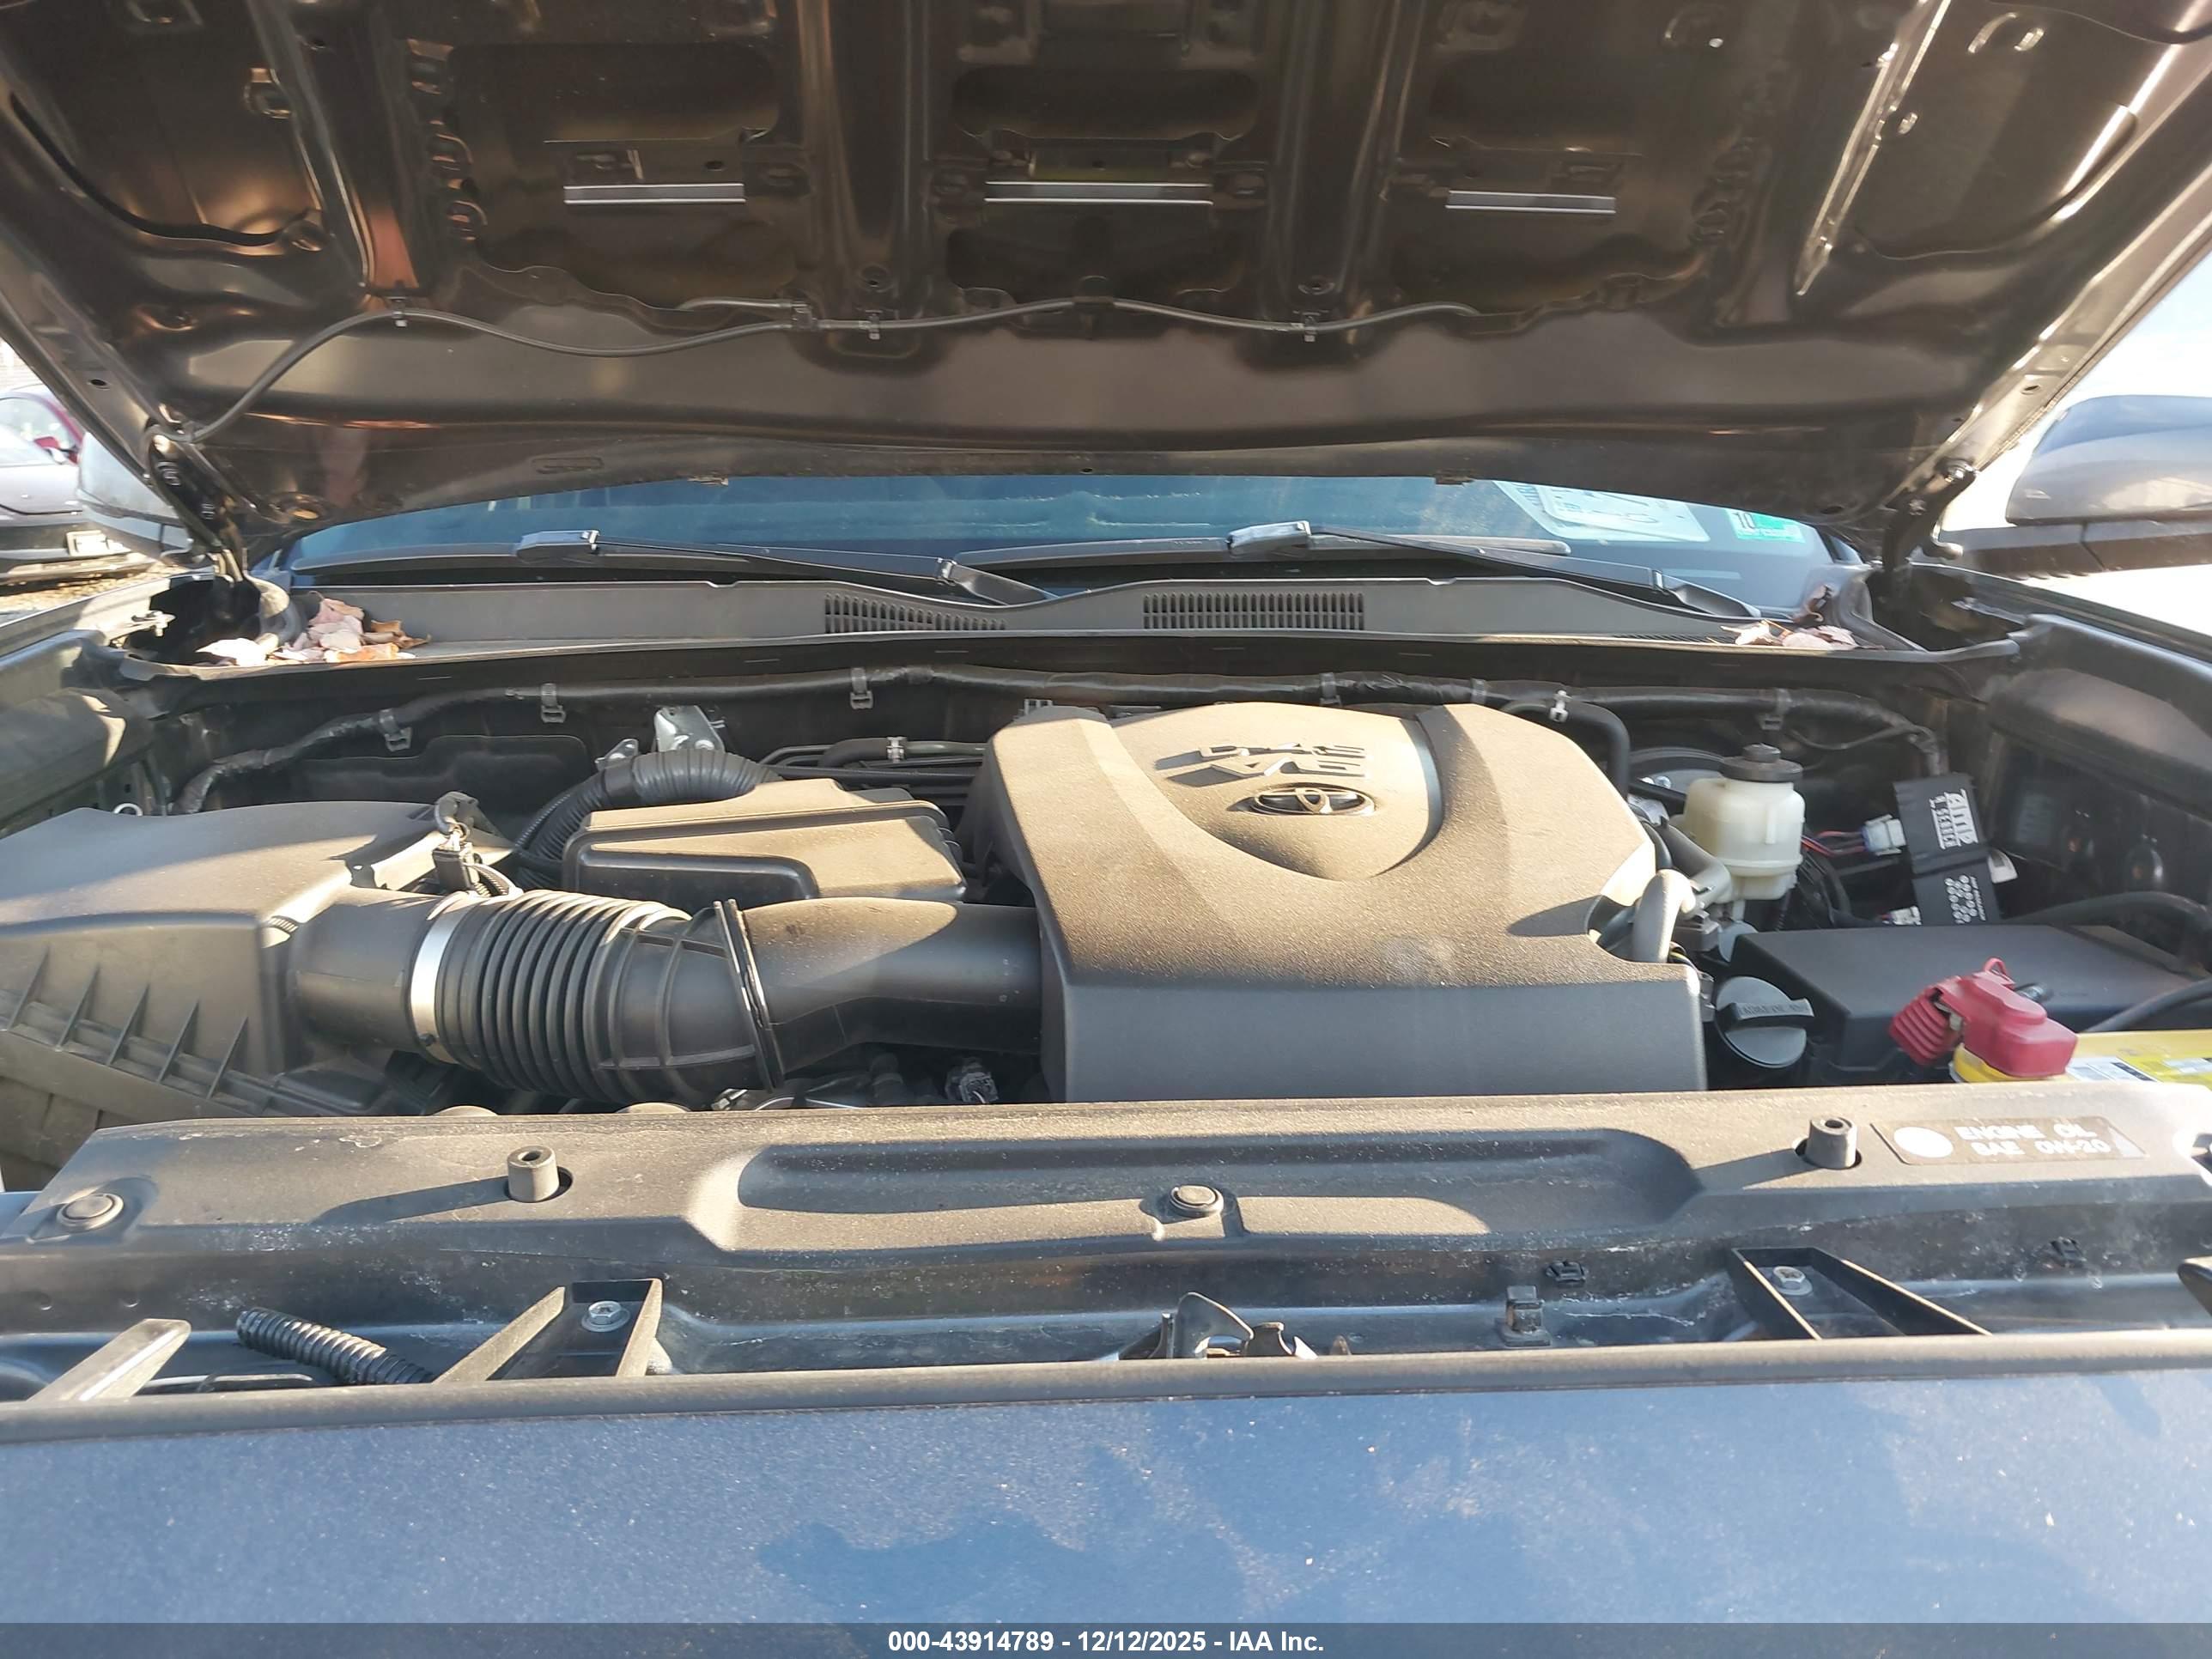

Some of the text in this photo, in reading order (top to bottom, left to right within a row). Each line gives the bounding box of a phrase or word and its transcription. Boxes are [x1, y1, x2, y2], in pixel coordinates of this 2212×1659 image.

[1954, 1123, 2097, 1139] ENGINE OIL
[1971, 1139, 2112, 1155] SAE 0W-20
